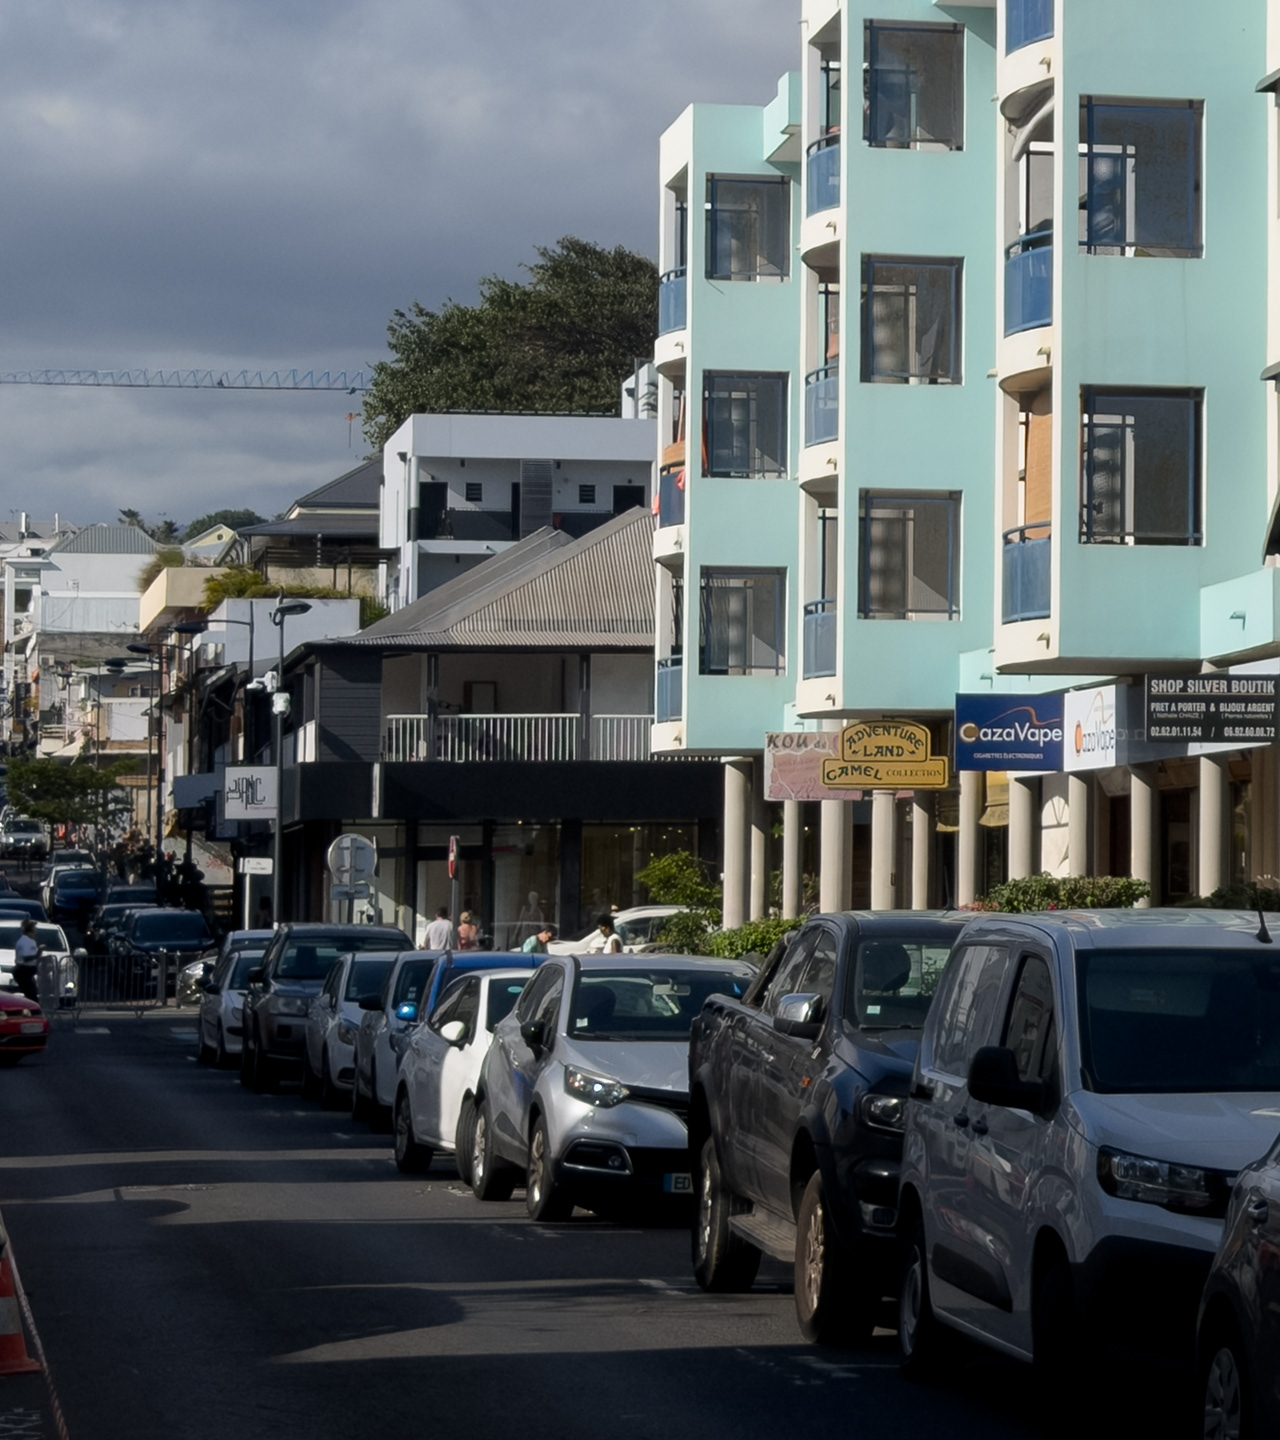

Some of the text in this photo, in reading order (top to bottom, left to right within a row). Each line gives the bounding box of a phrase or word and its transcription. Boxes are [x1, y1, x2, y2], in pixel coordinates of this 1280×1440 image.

[1151, 680, 1275, 693] SHOP SILVER BOUTIK
[1151, 702, 1275, 712] PRET A PORTER & BIJOUX ARGENT
[845, 725, 924, 751] ADVENTURE
[959, 722, 1063, 748] CazaVape
[864, 745, 905, 757] LAND
[826, 764, 942, 781] CAMEL COLLECTION
